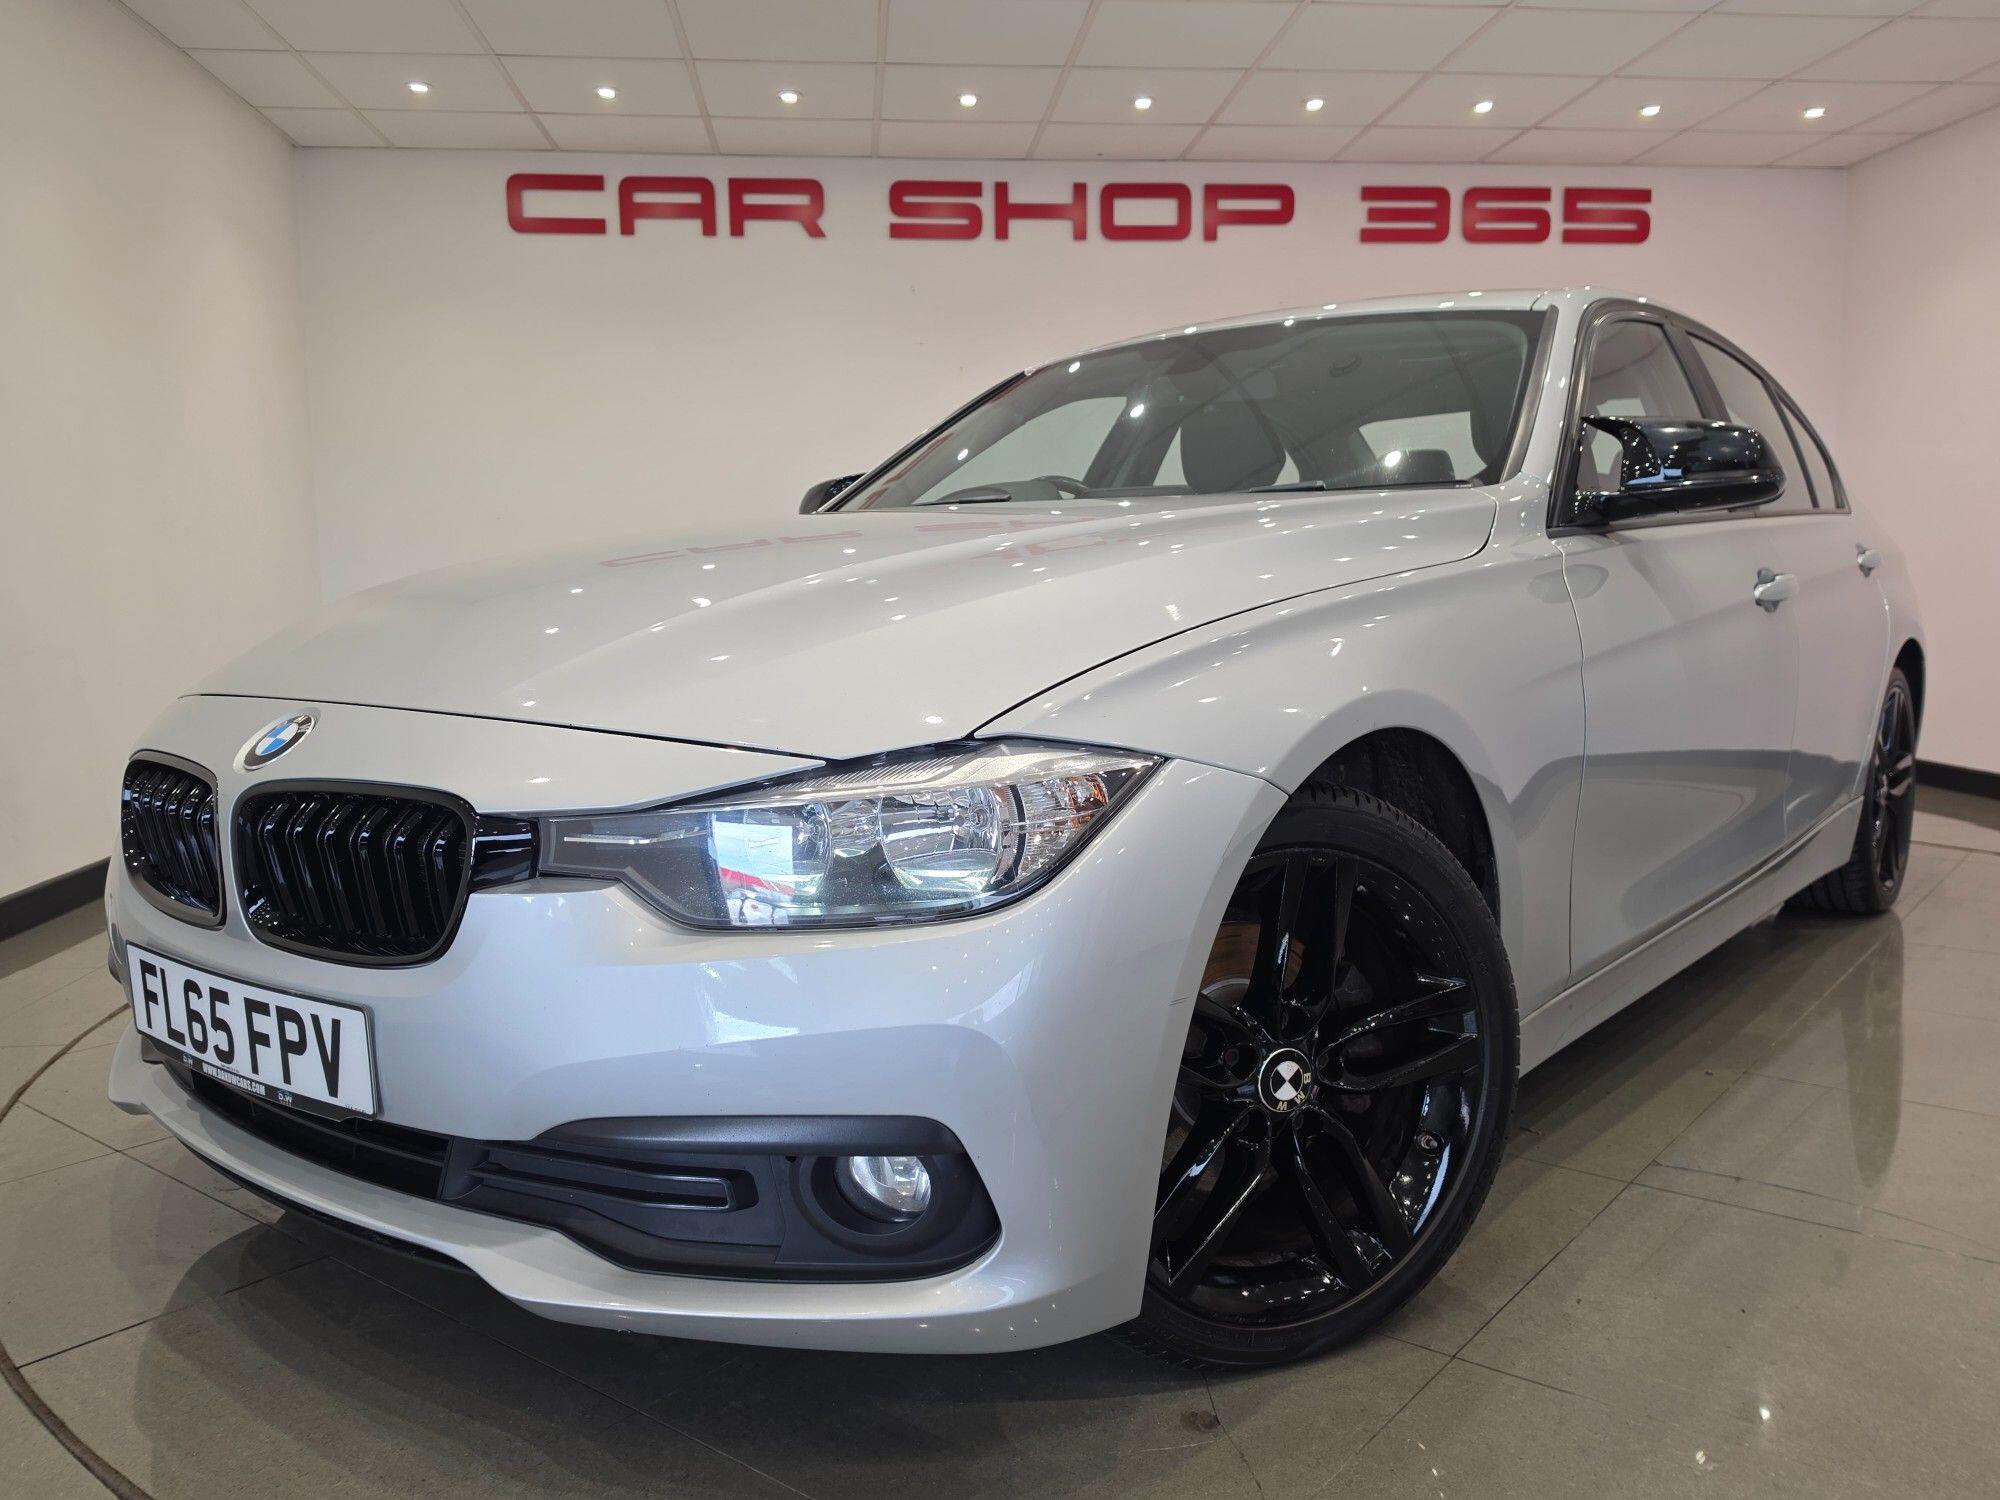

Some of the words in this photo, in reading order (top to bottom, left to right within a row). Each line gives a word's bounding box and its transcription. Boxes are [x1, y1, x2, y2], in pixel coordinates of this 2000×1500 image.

[506, 173, 827, 237] CAR
[889, 180, 1295, 242] SHOP
[1360, 186, 1652, 244] 365
[139, 958, 235, 1065] FL65
[243, 996, 341, 1099] FPV
